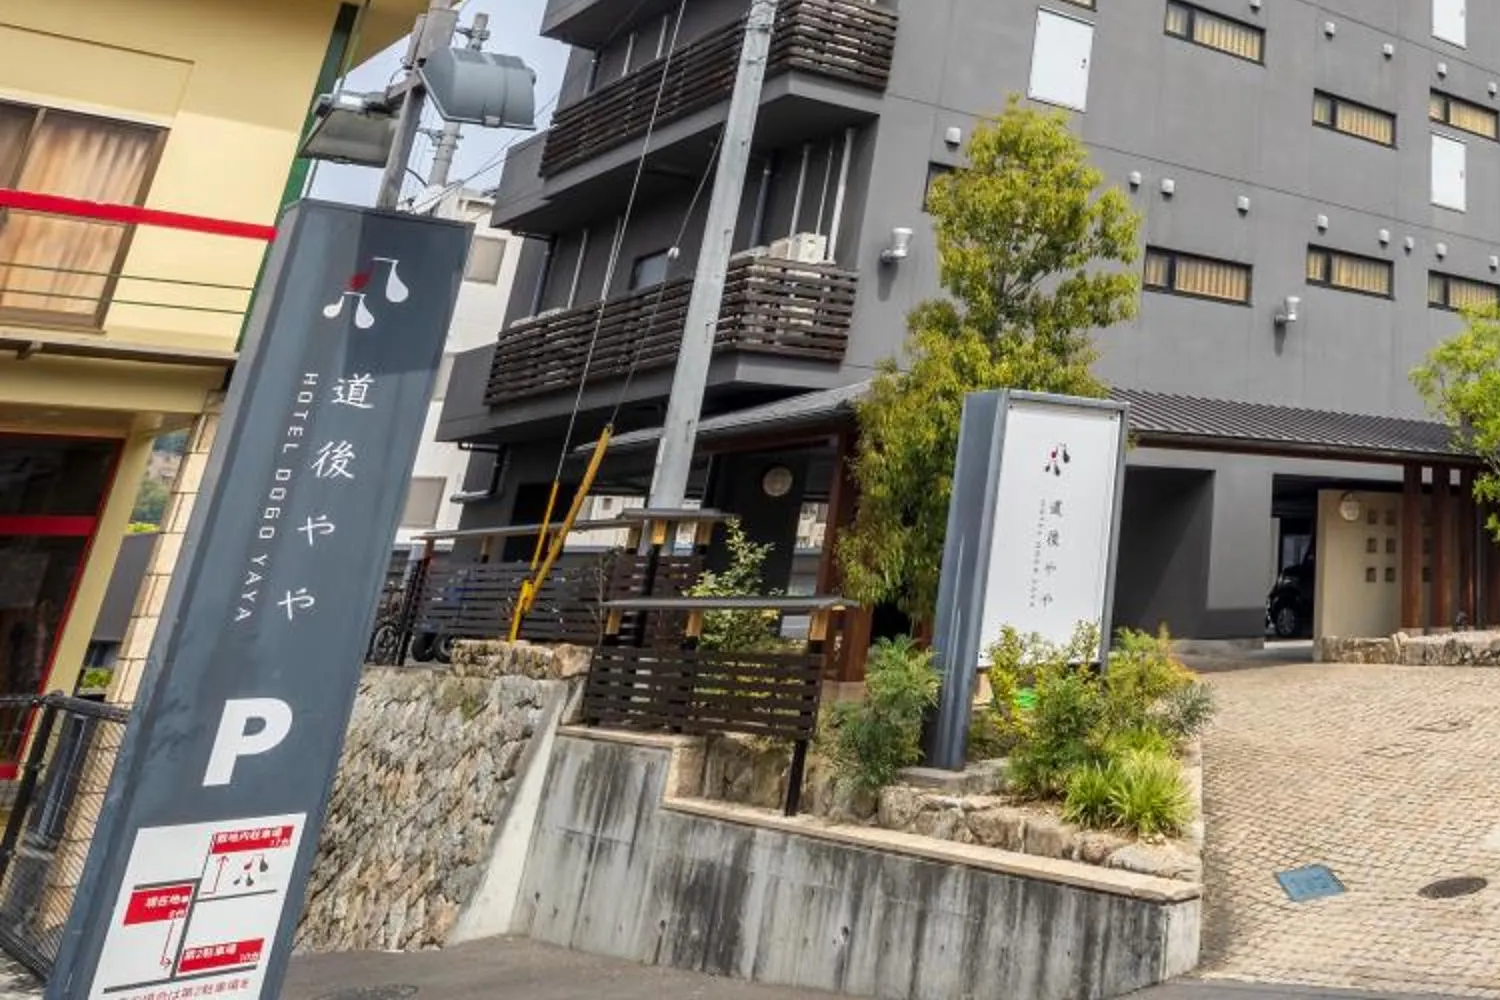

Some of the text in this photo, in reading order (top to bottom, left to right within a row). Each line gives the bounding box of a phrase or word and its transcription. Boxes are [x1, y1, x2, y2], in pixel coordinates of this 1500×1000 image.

[234, 373, 319, 622] HOTEL DOGO YAYA
[276, 372, 376, 622] 道後やや
[202, 697, 292, 787] P
